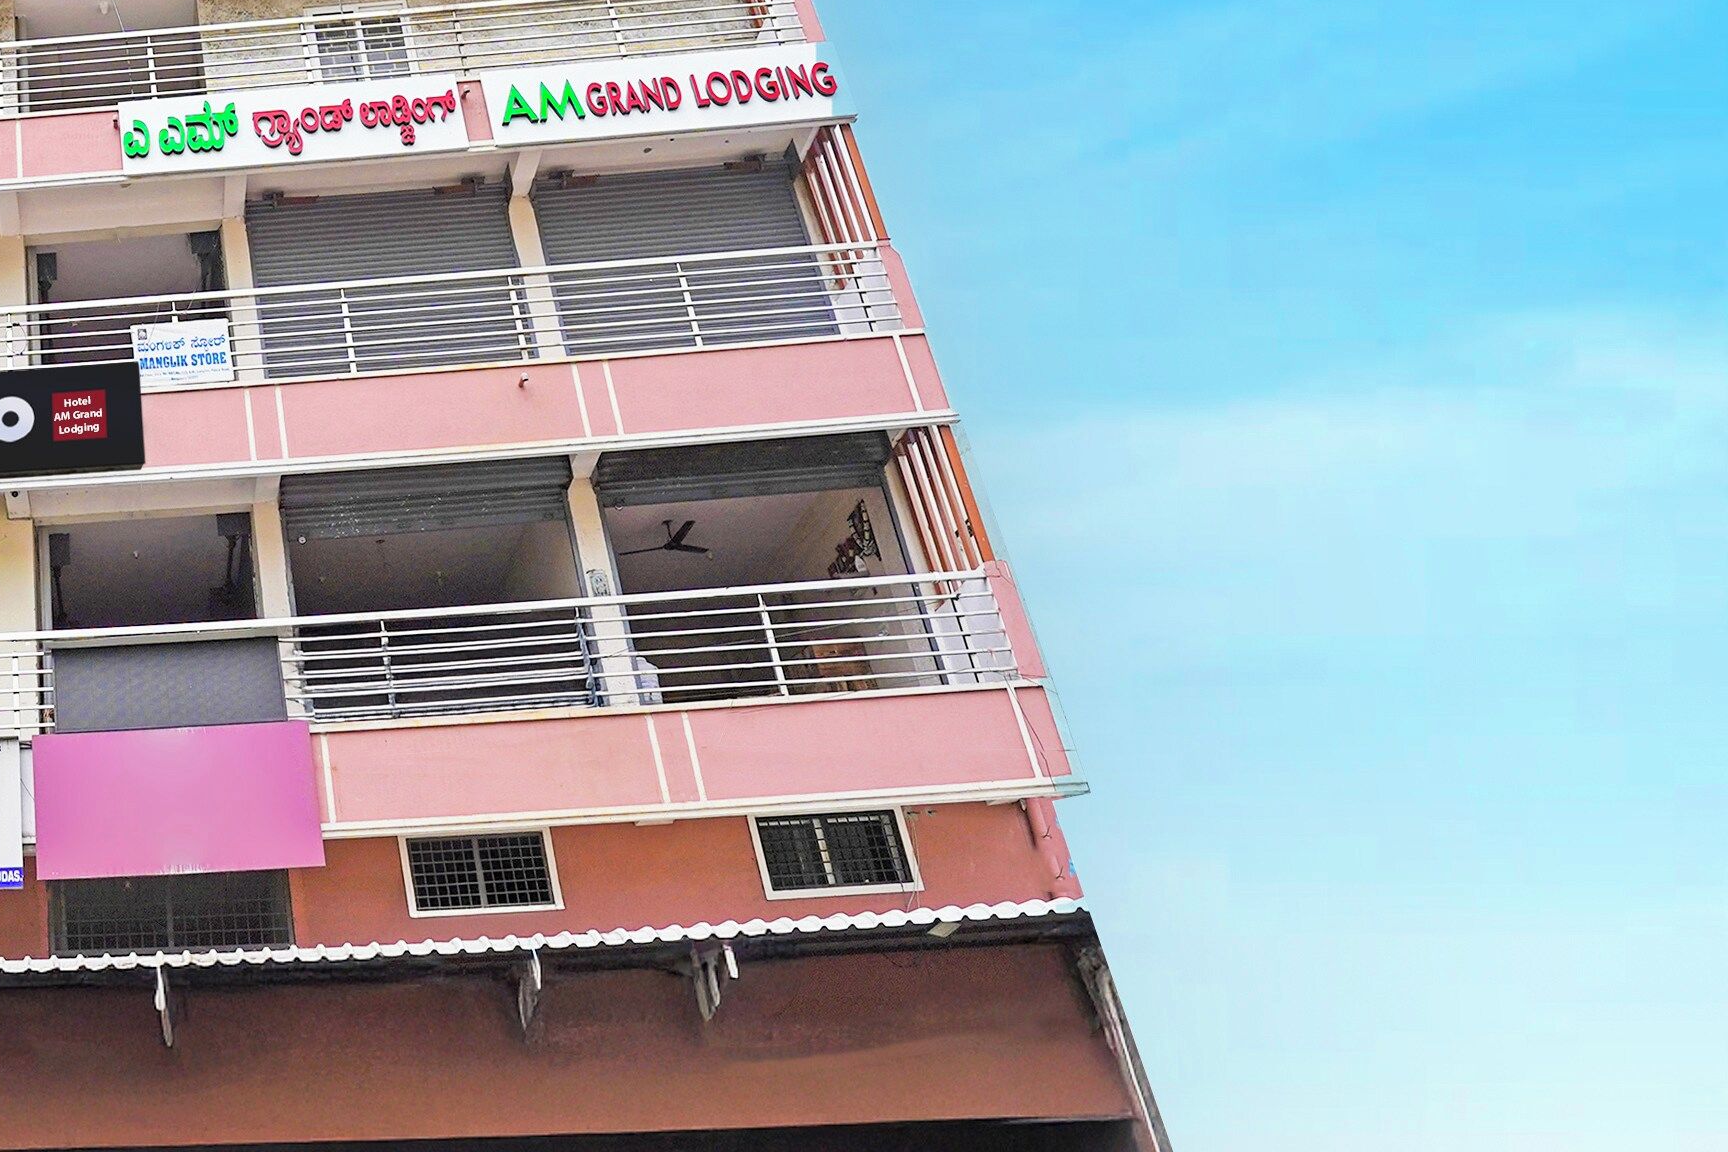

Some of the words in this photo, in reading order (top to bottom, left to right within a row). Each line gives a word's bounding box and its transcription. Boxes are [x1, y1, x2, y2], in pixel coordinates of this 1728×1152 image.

[502, 79, 585, 126] AM
[585, 76, 682, 117] GRAND
[690, 62, 838, 108] LODGING
[140, 355, 188, 370] MANGLIK
[191, 352, 227, 366] STORE
[63, 396, 91, 407] Hotel
[54, 410, 71, 422] AM
[73, 408, 103, 419] Grand
[59, 422, 100, 436] Lodging
